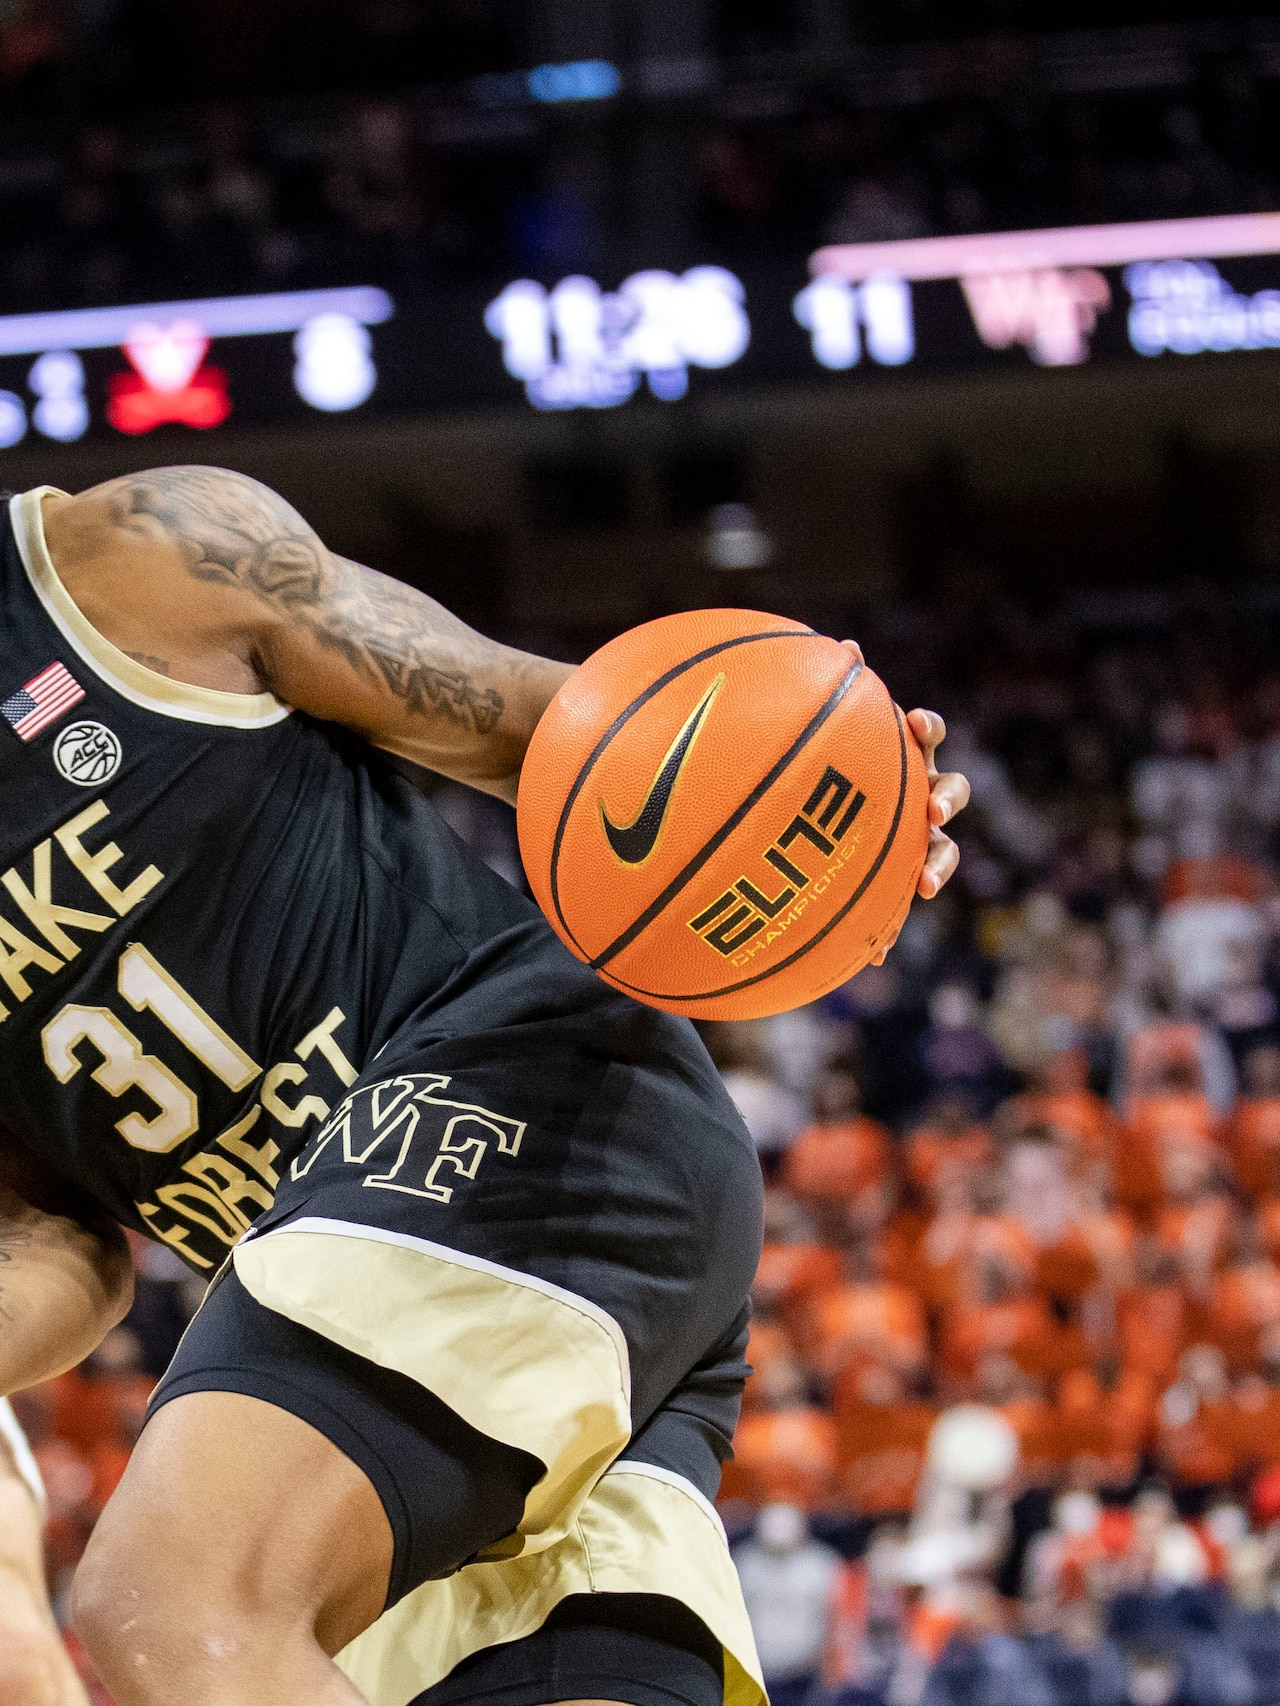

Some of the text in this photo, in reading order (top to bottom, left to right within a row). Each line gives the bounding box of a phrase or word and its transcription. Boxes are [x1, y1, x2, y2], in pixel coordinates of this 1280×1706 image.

[70, 730, 109, 769] ACC
[686, 764, 867, 957] ELITE
[41, 942, 263, 1153] 31
[134, 1006, 360, 1268] FOREST
[290, 1073, 527, 1204] WF
